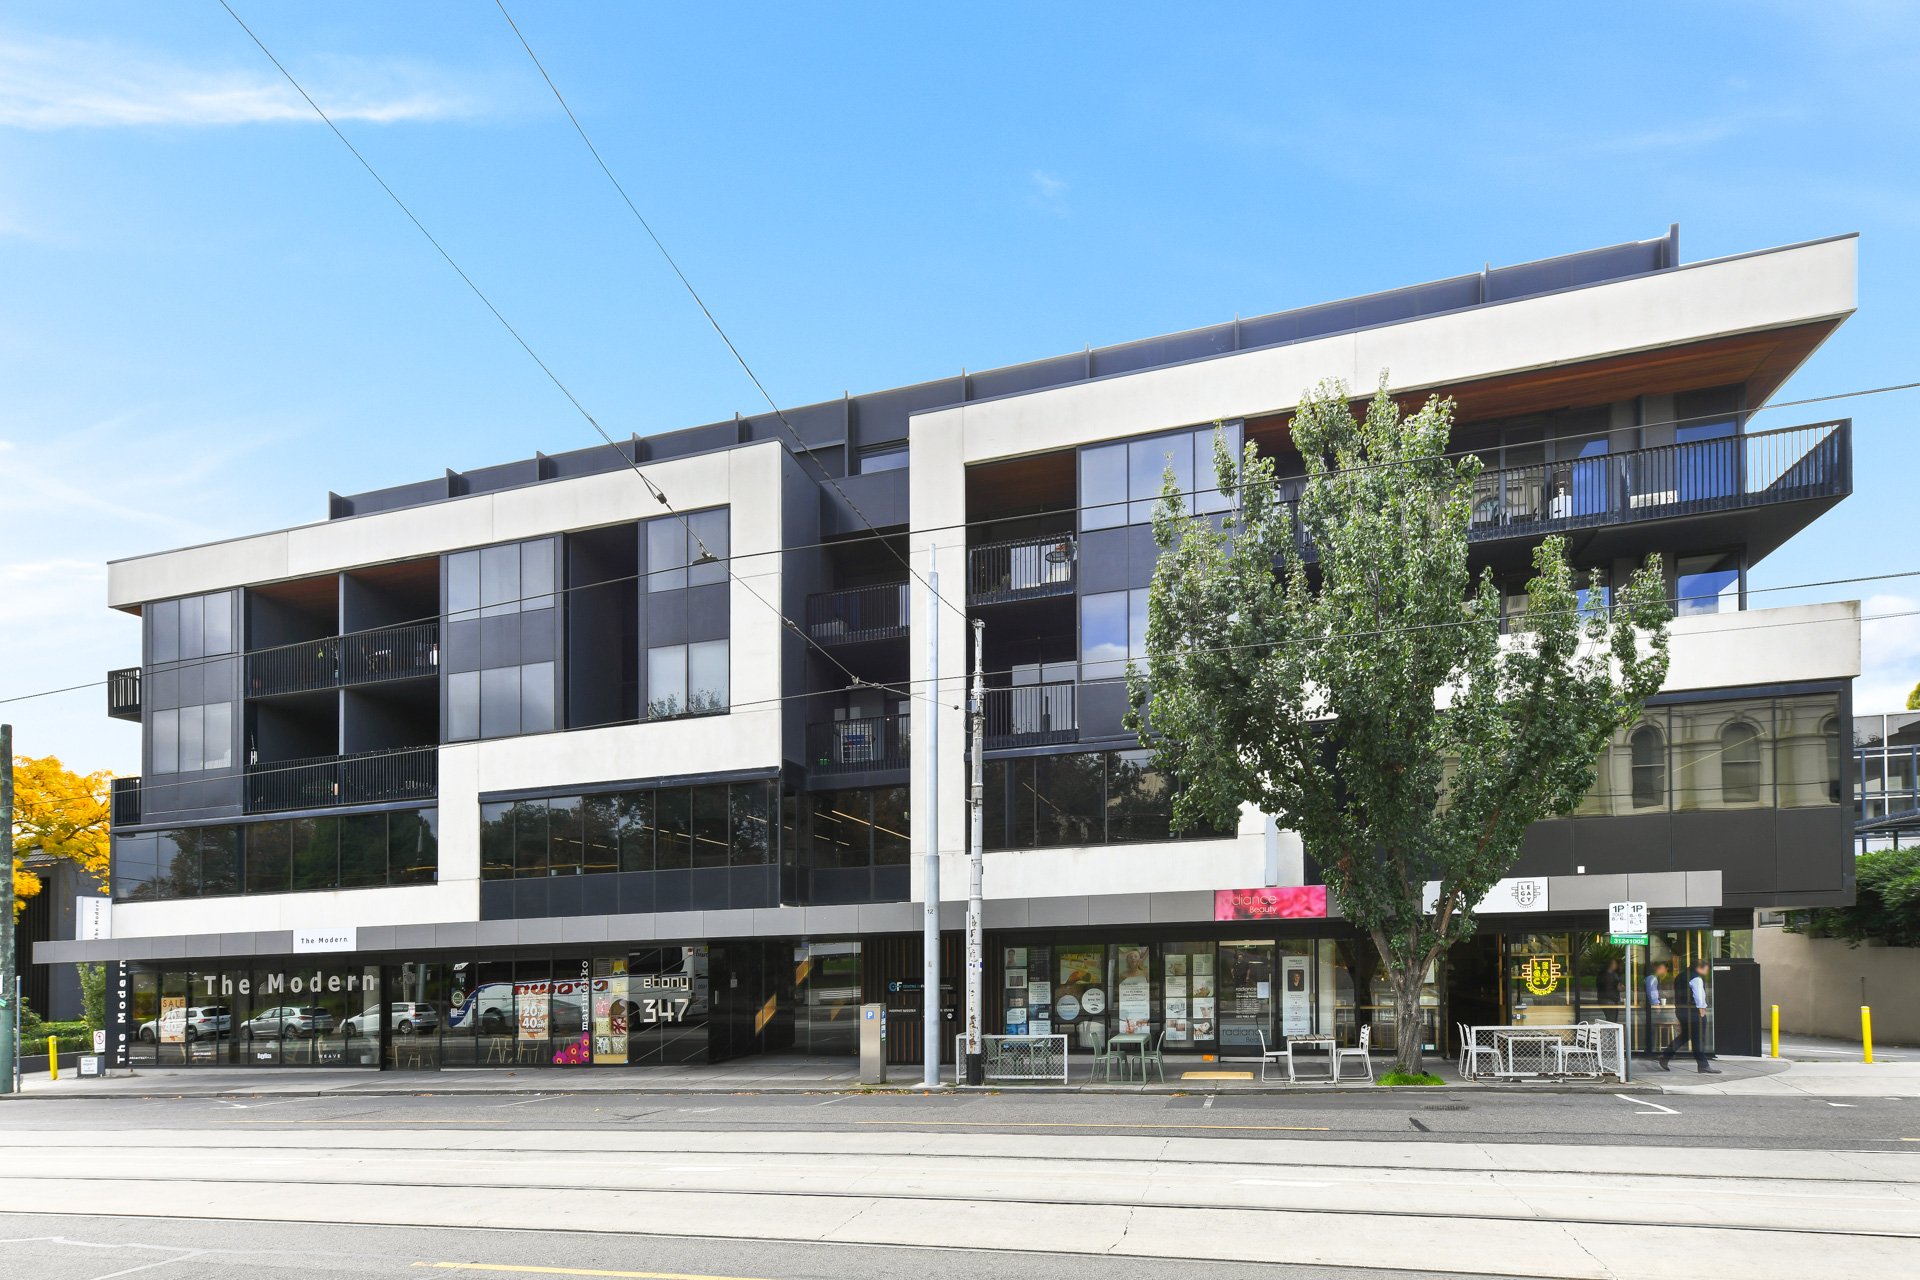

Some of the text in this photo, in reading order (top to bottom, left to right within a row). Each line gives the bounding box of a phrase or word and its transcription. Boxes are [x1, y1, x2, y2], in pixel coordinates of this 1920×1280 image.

[1612, 905, 1625, 913] 1P
[1630, 905, 1643, 913] 1P
[203, 971, 375, 995] The Modern
[643, 974, 689, 991] ebony
[162, 999, 184, 1008] SALE
[117, 960, 127, 1064] The Modern
[523, 1006, 537, 1016] 20
[643, 999, 689, 1023] 347
[522, 1017, 537, 1028] 40
